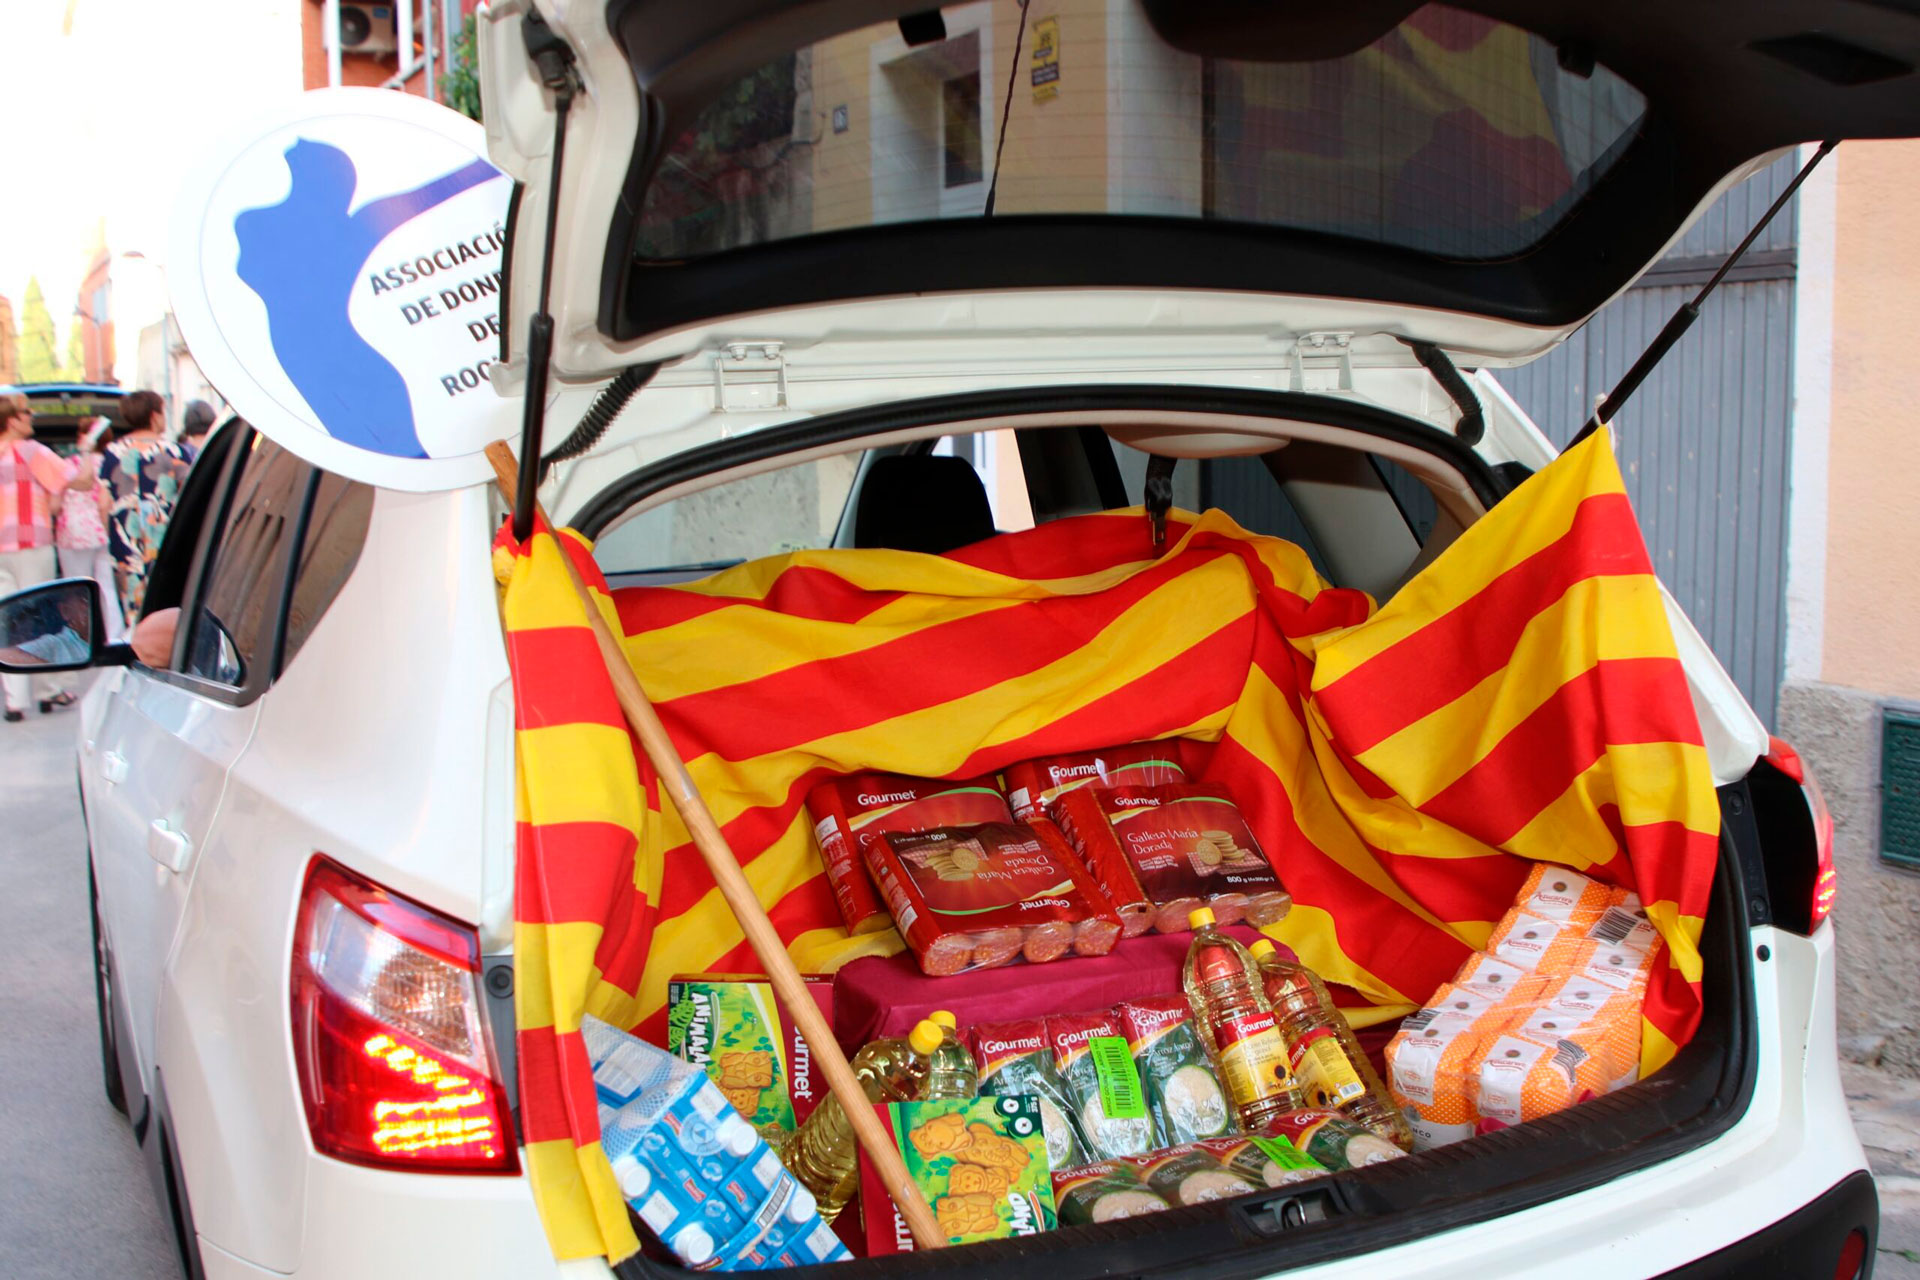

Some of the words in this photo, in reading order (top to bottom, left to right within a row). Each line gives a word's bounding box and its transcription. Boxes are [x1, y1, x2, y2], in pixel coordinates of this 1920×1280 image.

[400, 296, 441, 325] DE
[857, 790, 917, 806] Gourmet
[1115, 796, 1160, 806] Gourmet
[1127, 830, 1167, 844] Galleta
[1168, 827, 1199, 840] María
[1133, 839, 1173, 854] Dorada
[1005, 855, 1049, 868] Dorada
[1013, 865, 1055, 876] Galleta
[1019, 899, 1070, 911] Gourmet
[1238, 1018, 1275, 1033] Gourmet
[1057, 1022, 1113, 1046] Gourmet
[984, 1036, 1043, 1054] Gourmet
[1055, 1164, 1114, 1183] Gourmet
